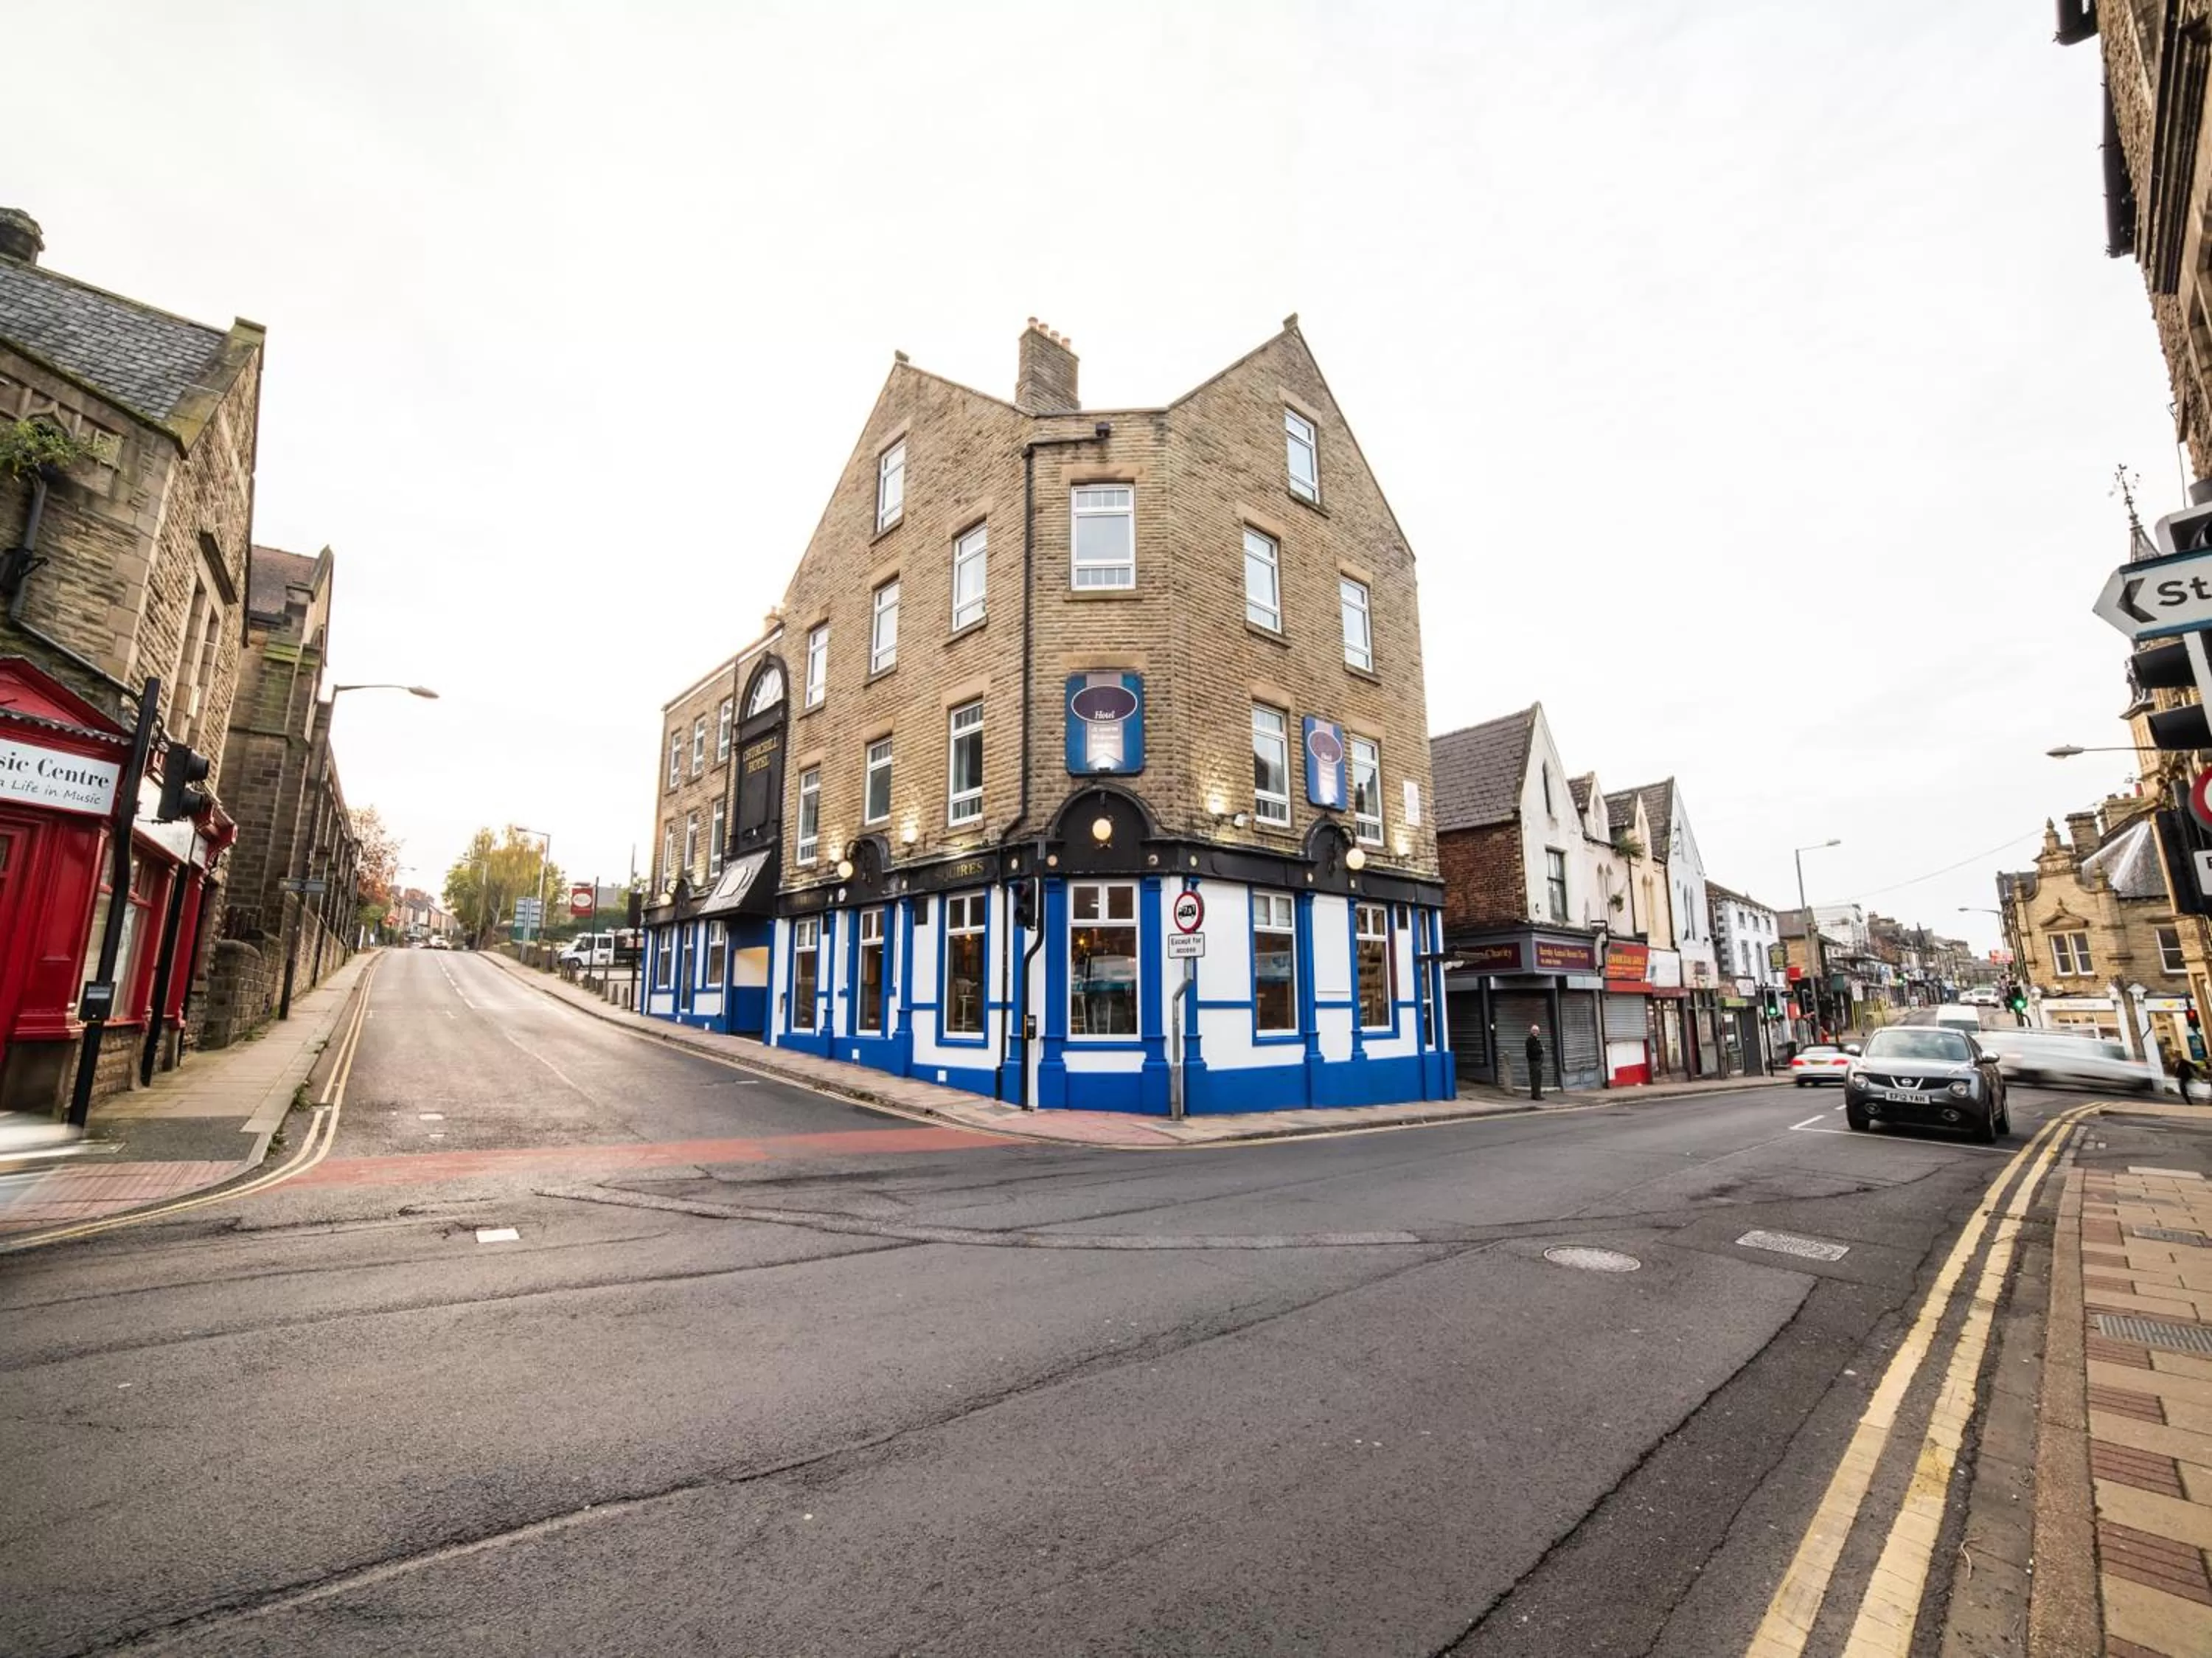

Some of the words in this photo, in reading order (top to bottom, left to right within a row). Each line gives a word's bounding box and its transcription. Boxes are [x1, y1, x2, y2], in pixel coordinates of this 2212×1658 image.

[2157, 576, 2212, 606] St
[1094, 710, 1116, 720] Hotel
[38, 758, 109, 788] Centre
[11, 780, 39, 793] Life
[44, 785, 58, 797] in
[64, 790, 101, 805] Music
[1171, 937, 1191, 946] Except
